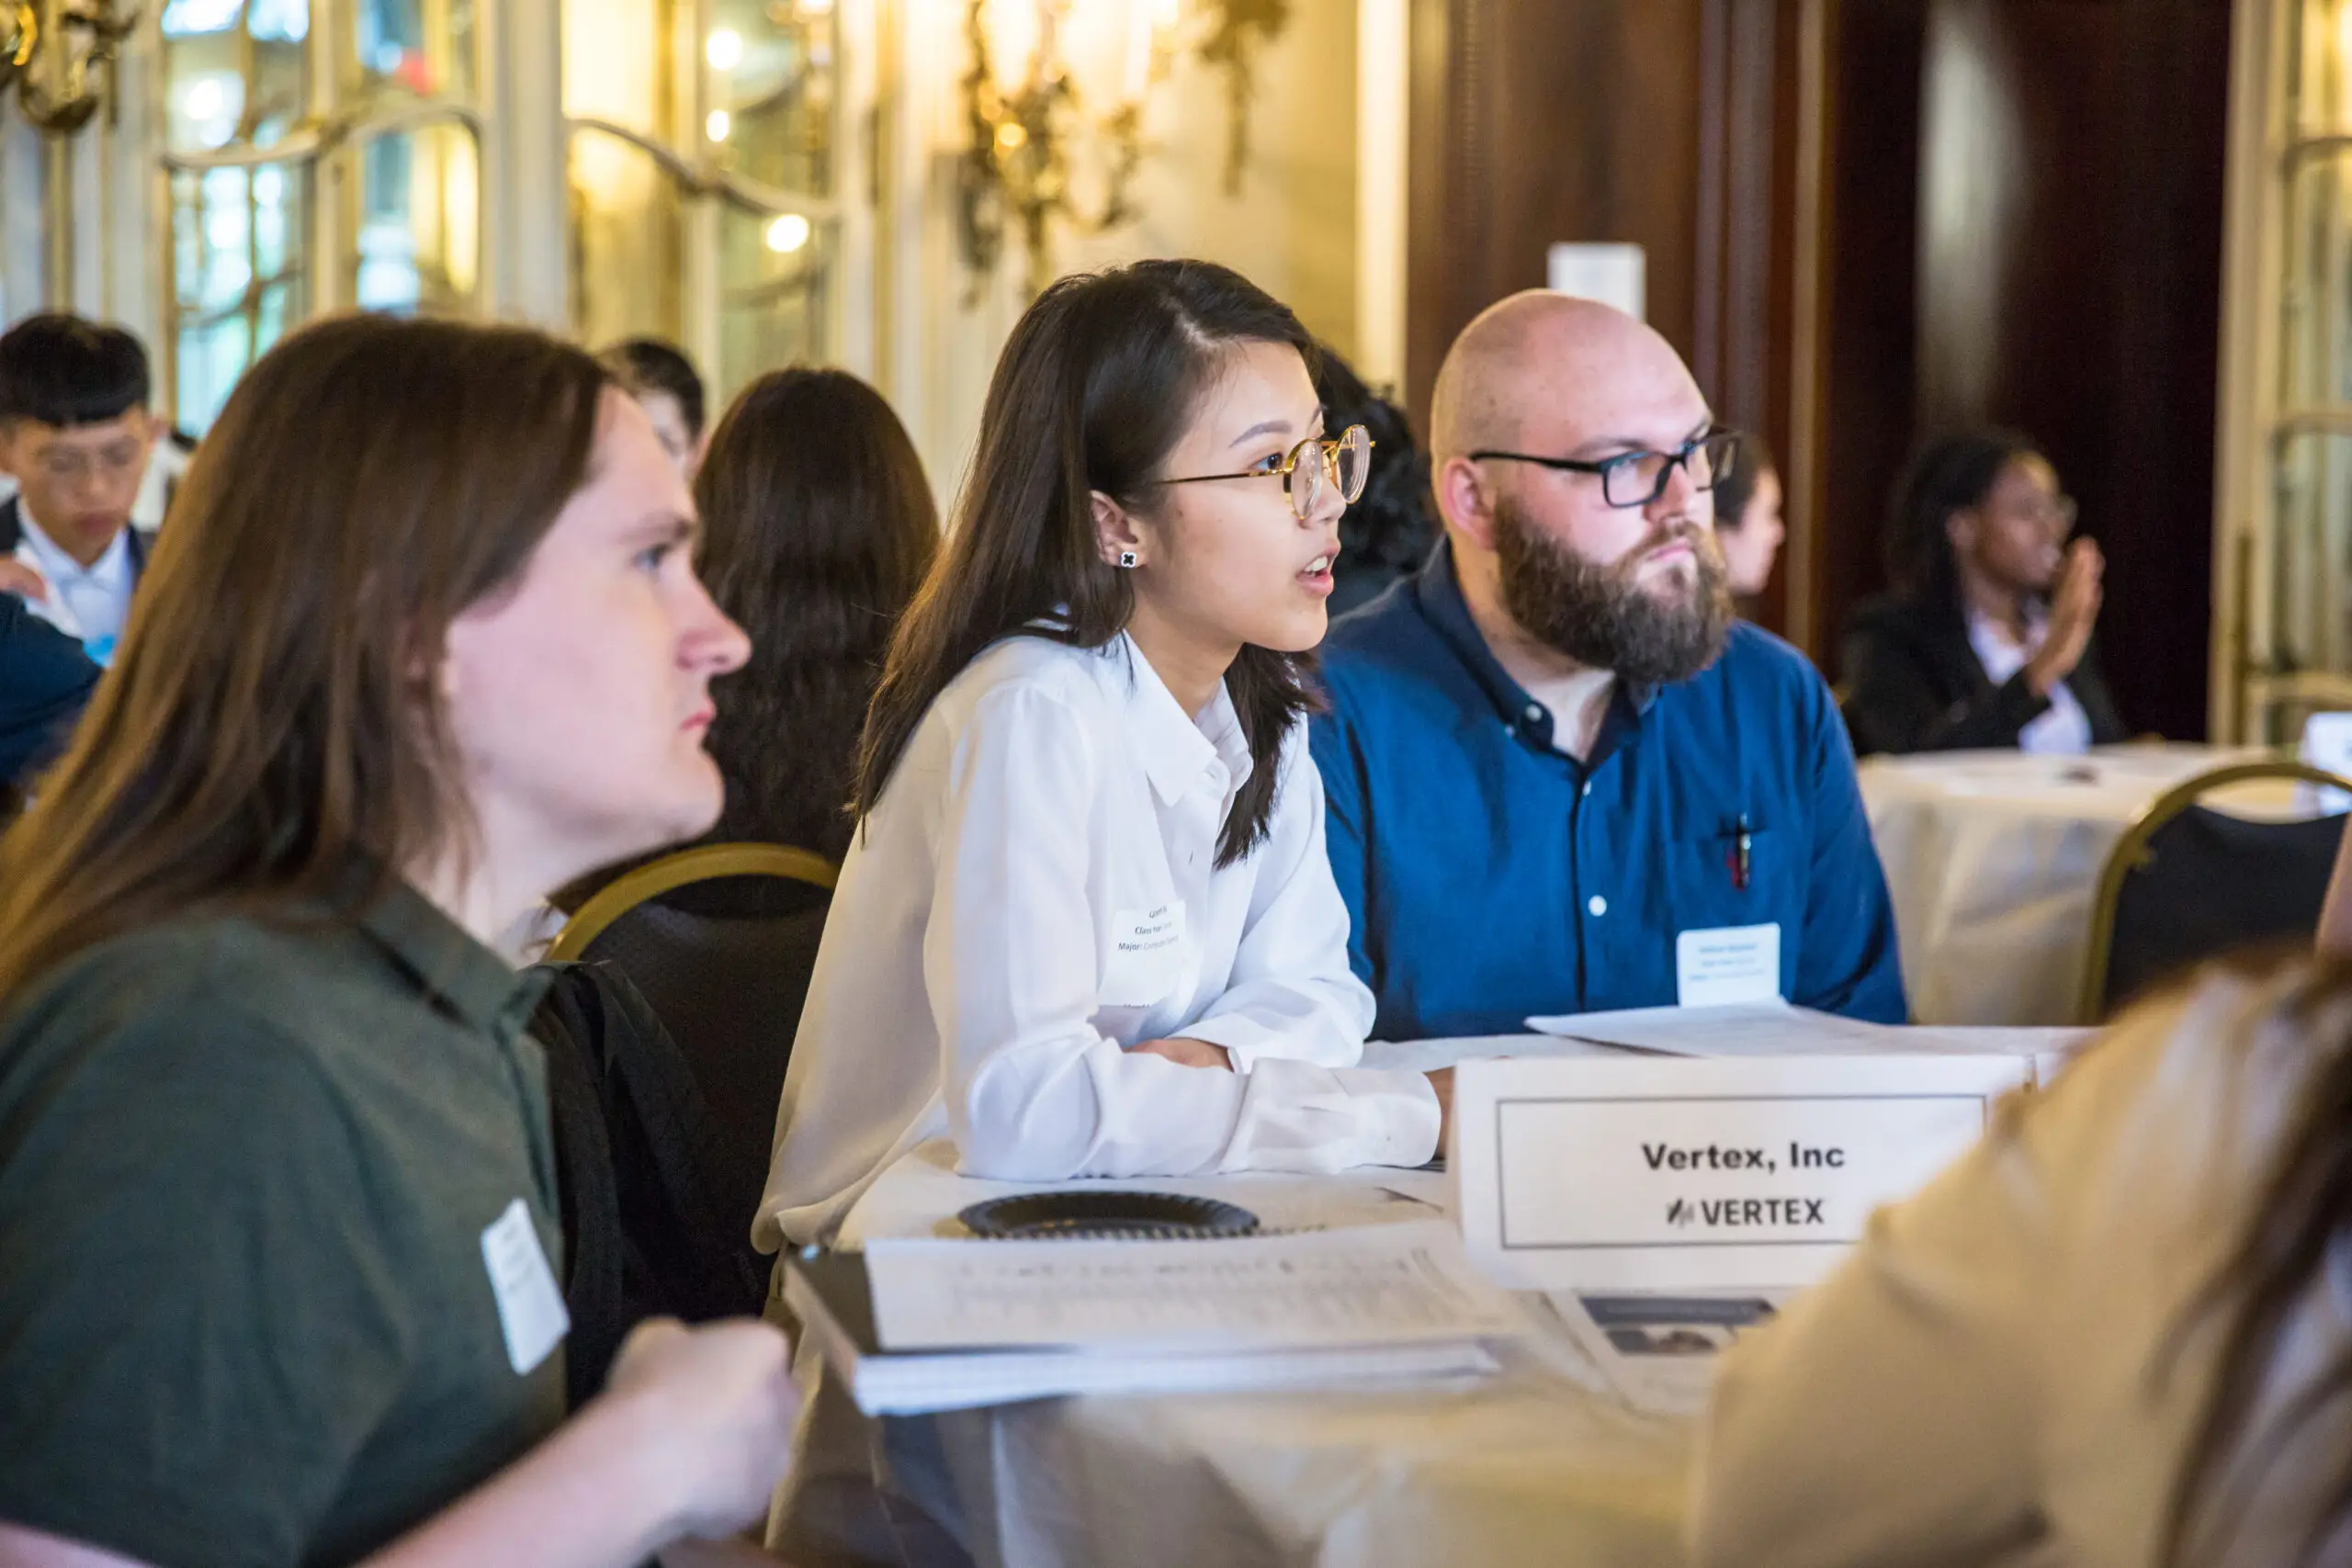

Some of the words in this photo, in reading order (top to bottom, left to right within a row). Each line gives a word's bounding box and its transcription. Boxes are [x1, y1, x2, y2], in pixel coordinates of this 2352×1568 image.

[1642, 1143, 1776, 1175] Vertex,
[1790, 1141, 1845, 1168] Inc
[1702, 1198, 1824, 1226] VERTEX
